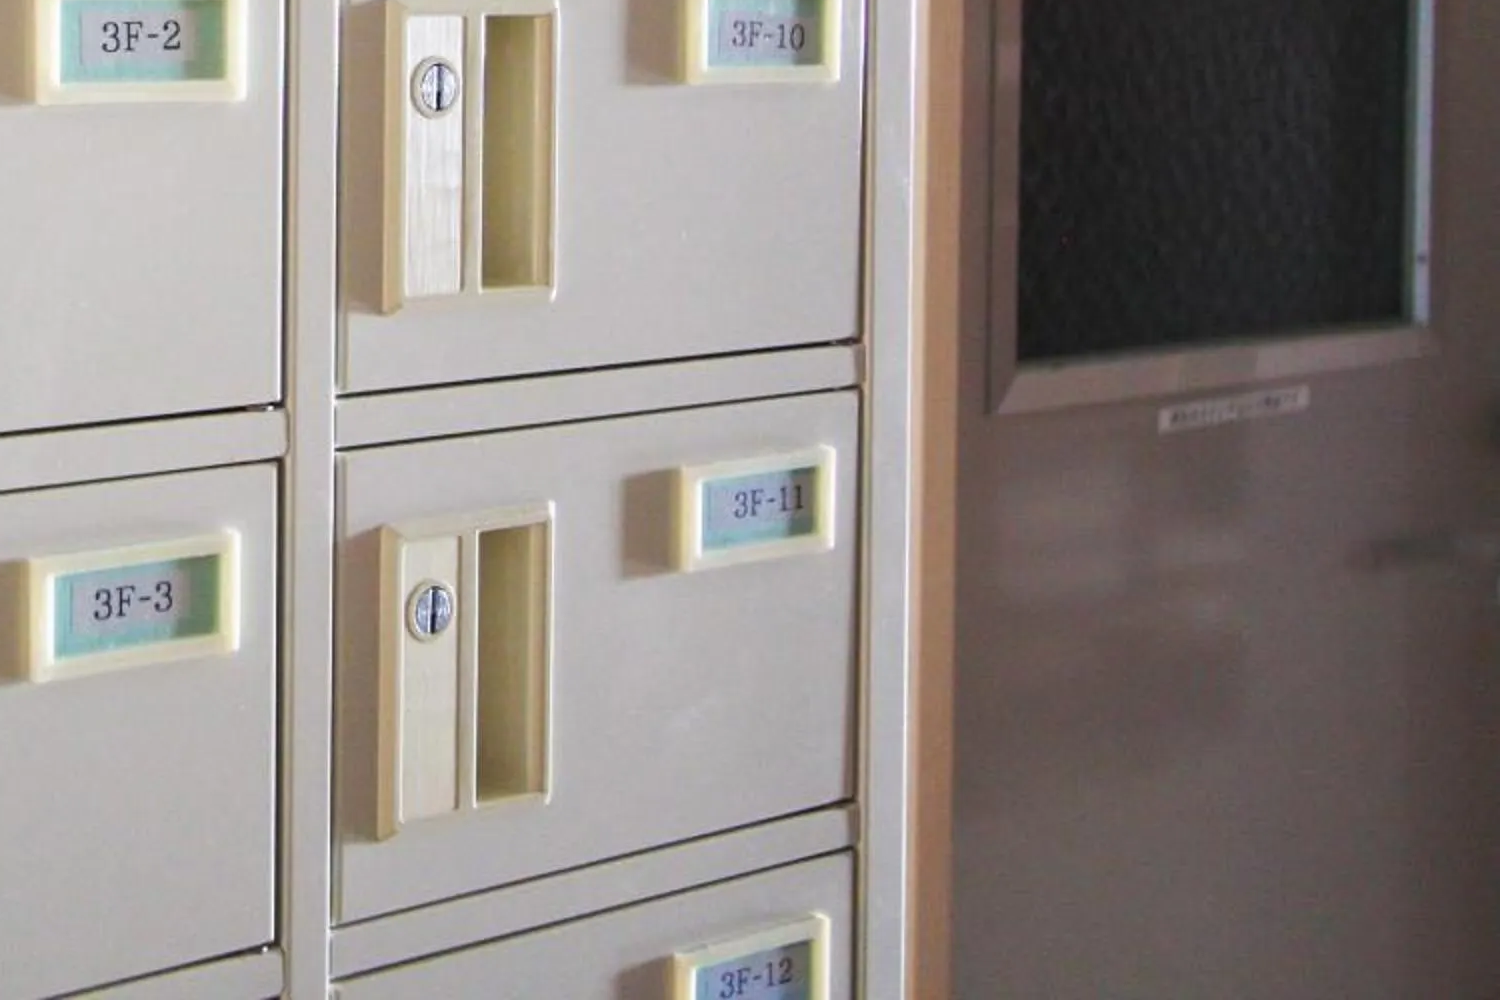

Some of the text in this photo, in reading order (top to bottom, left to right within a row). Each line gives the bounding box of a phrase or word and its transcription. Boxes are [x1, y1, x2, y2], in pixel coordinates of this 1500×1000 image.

[102, 20, 182, 53] 3F-2
[731, 21, 805, 51] 3F-10
[734, 485, 804, 519] 3F-11
[93, 581, 174, 621] 3F-3
[719, 956, 793, 999] 3F-12
